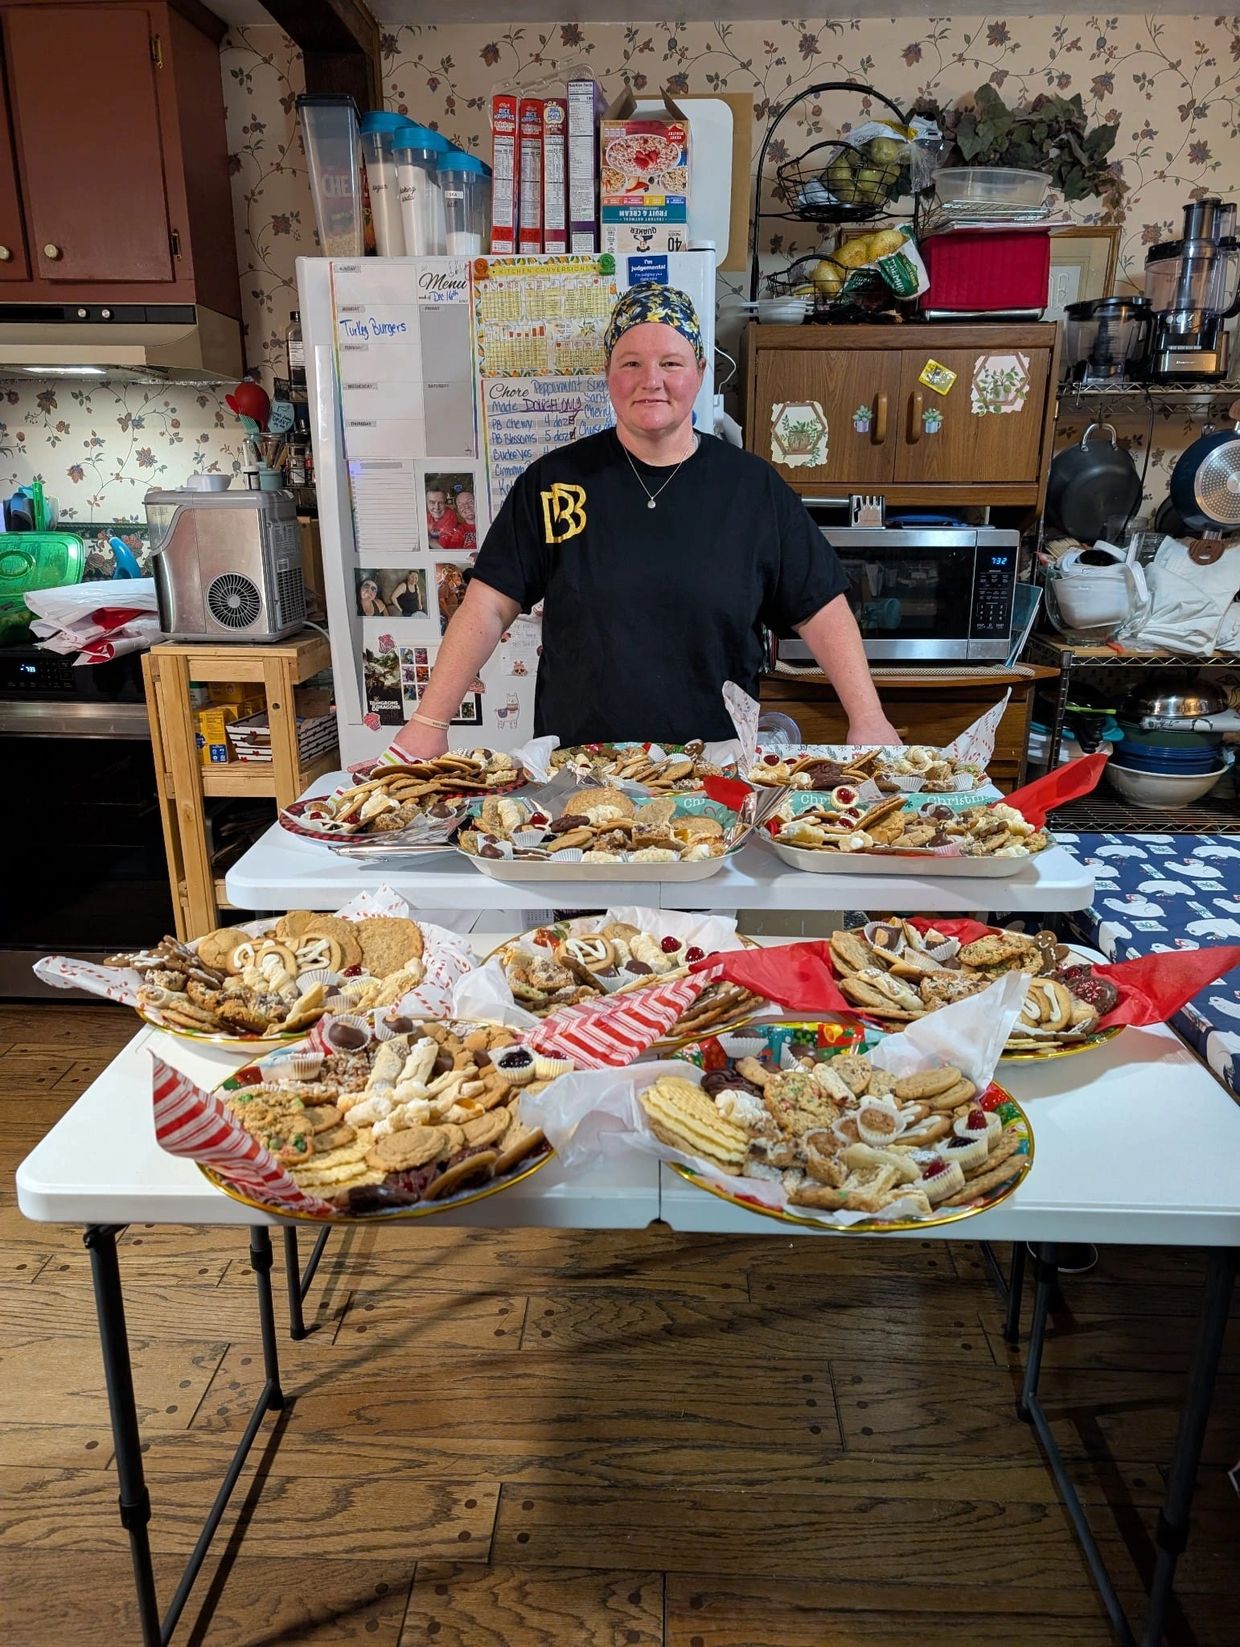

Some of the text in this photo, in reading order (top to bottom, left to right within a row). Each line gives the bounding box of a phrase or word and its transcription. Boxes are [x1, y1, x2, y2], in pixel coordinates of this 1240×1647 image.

[667, 238, 682, 252] 40
[631, 264, 666, 272] judgemental
[418, 272, 468, 291] Menu
[369, 317, 407, 336] Burgers
[489, 383, 530, 400] Chore
[531, 377, 581, 397] Peppermint
[492, 400, 518, 412] Made
[523, 398, 558, 411] DOUGH
[583, 392, 608, 405] Sant
[491, 419, 503, 430] PB
[491, 432, 503, 444] PB
[544, 430, 551, 441] 5
[800, 795, 832, 806] Chri
[927, 794, 987, 806] Christm
